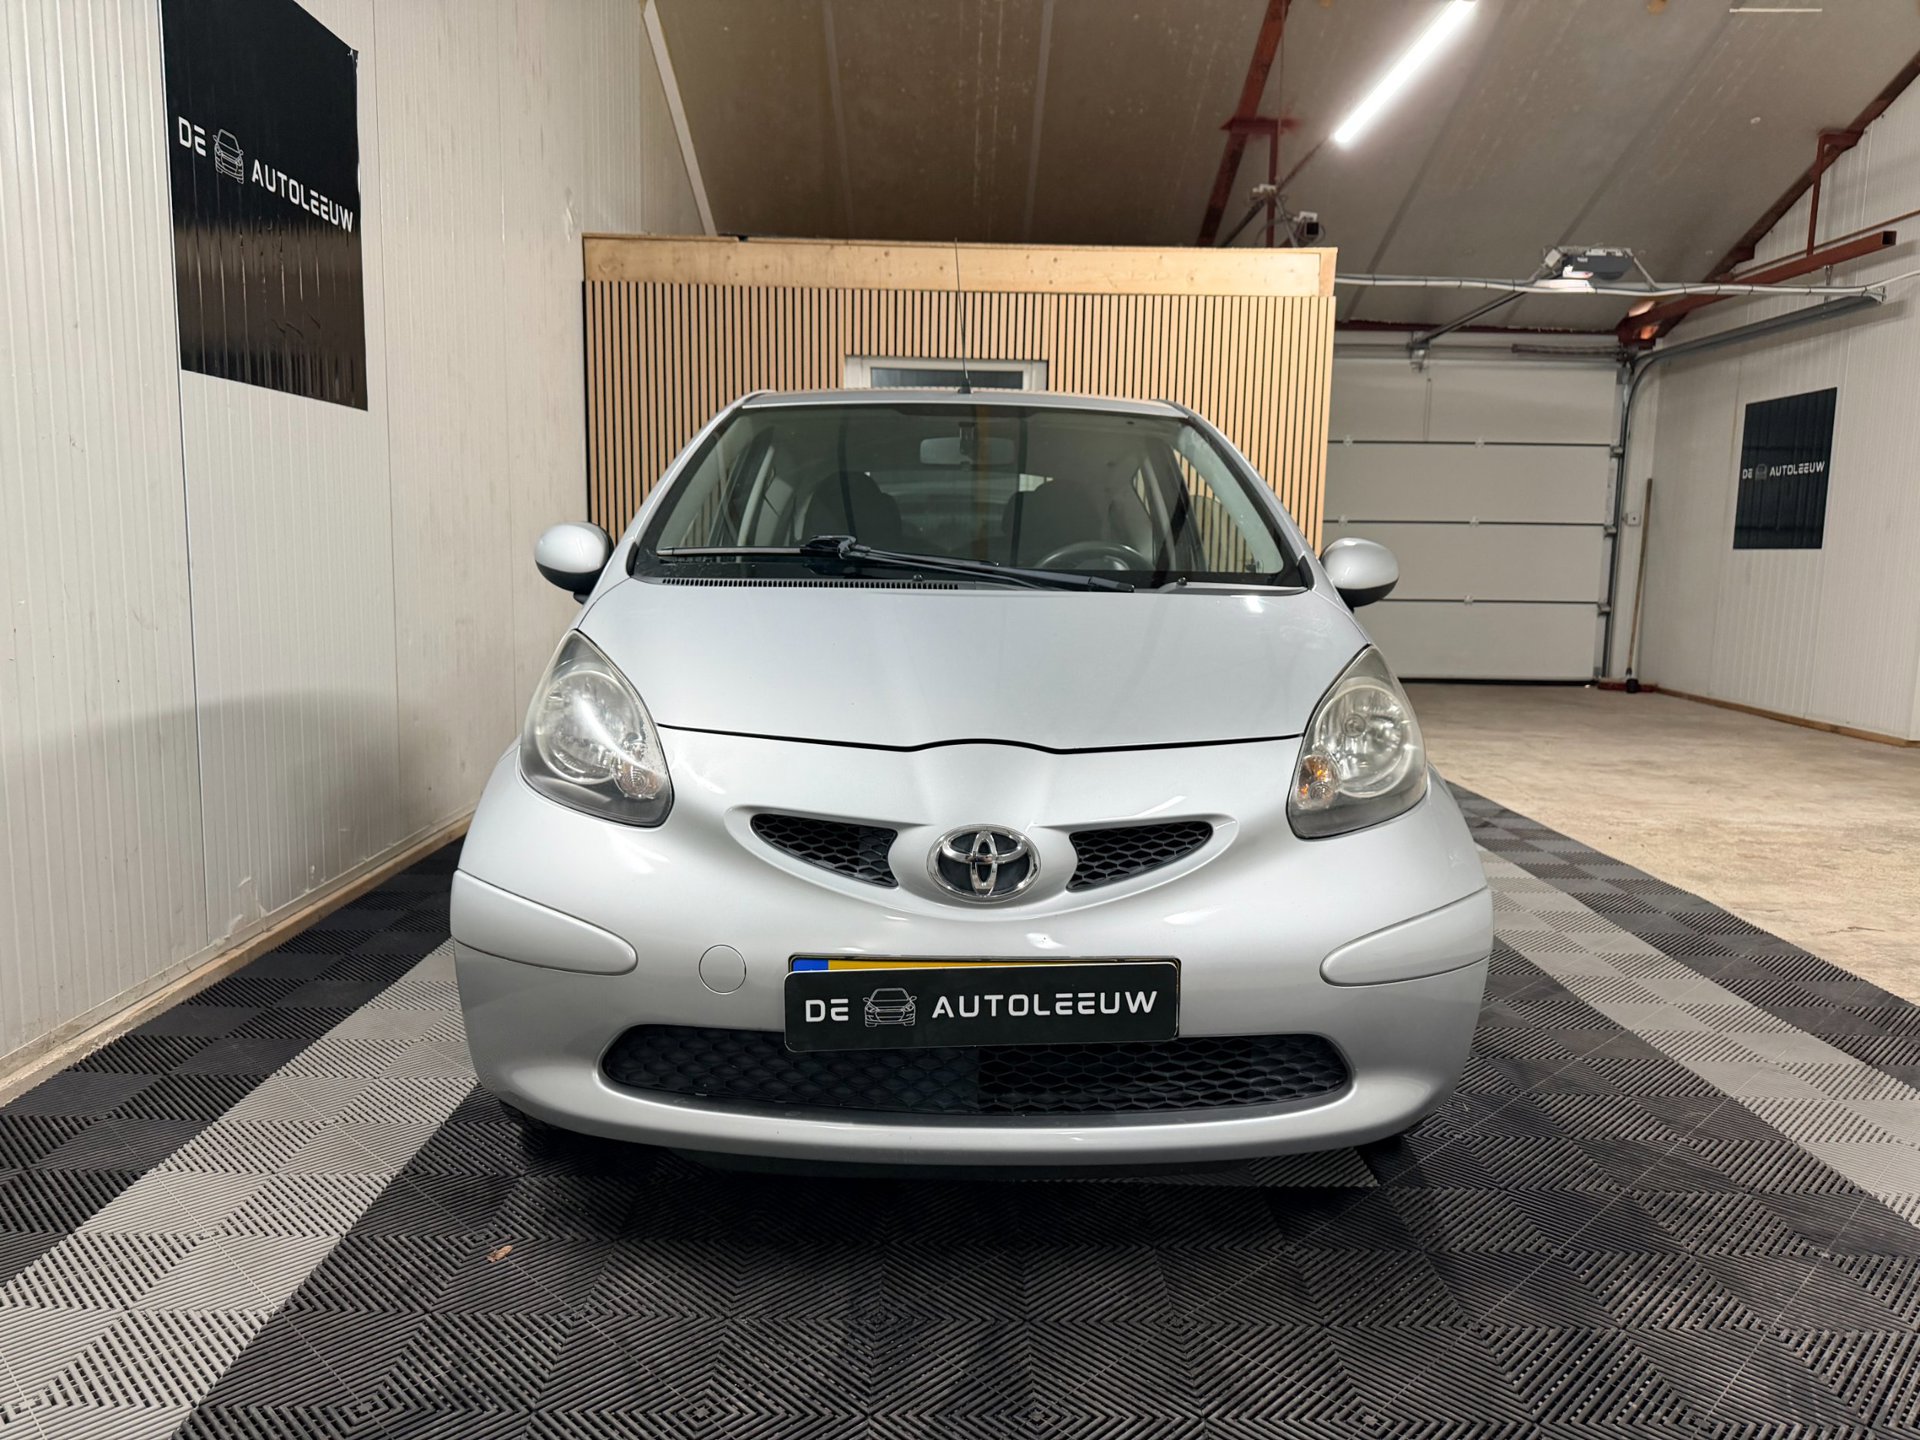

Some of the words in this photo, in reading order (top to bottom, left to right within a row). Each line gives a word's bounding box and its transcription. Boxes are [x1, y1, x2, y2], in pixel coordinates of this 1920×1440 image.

[178, 116, 207, 157] DE
[252, 158, 354, 233] AUTOLEEUW
[1742, 468, 1753, 479] DE
[1769, 461, 1825, 477] AUTOLEEUW
[804, 998, 849, 1023] DE
[932, 990, 1158, 1019] AUTOLEEUW
